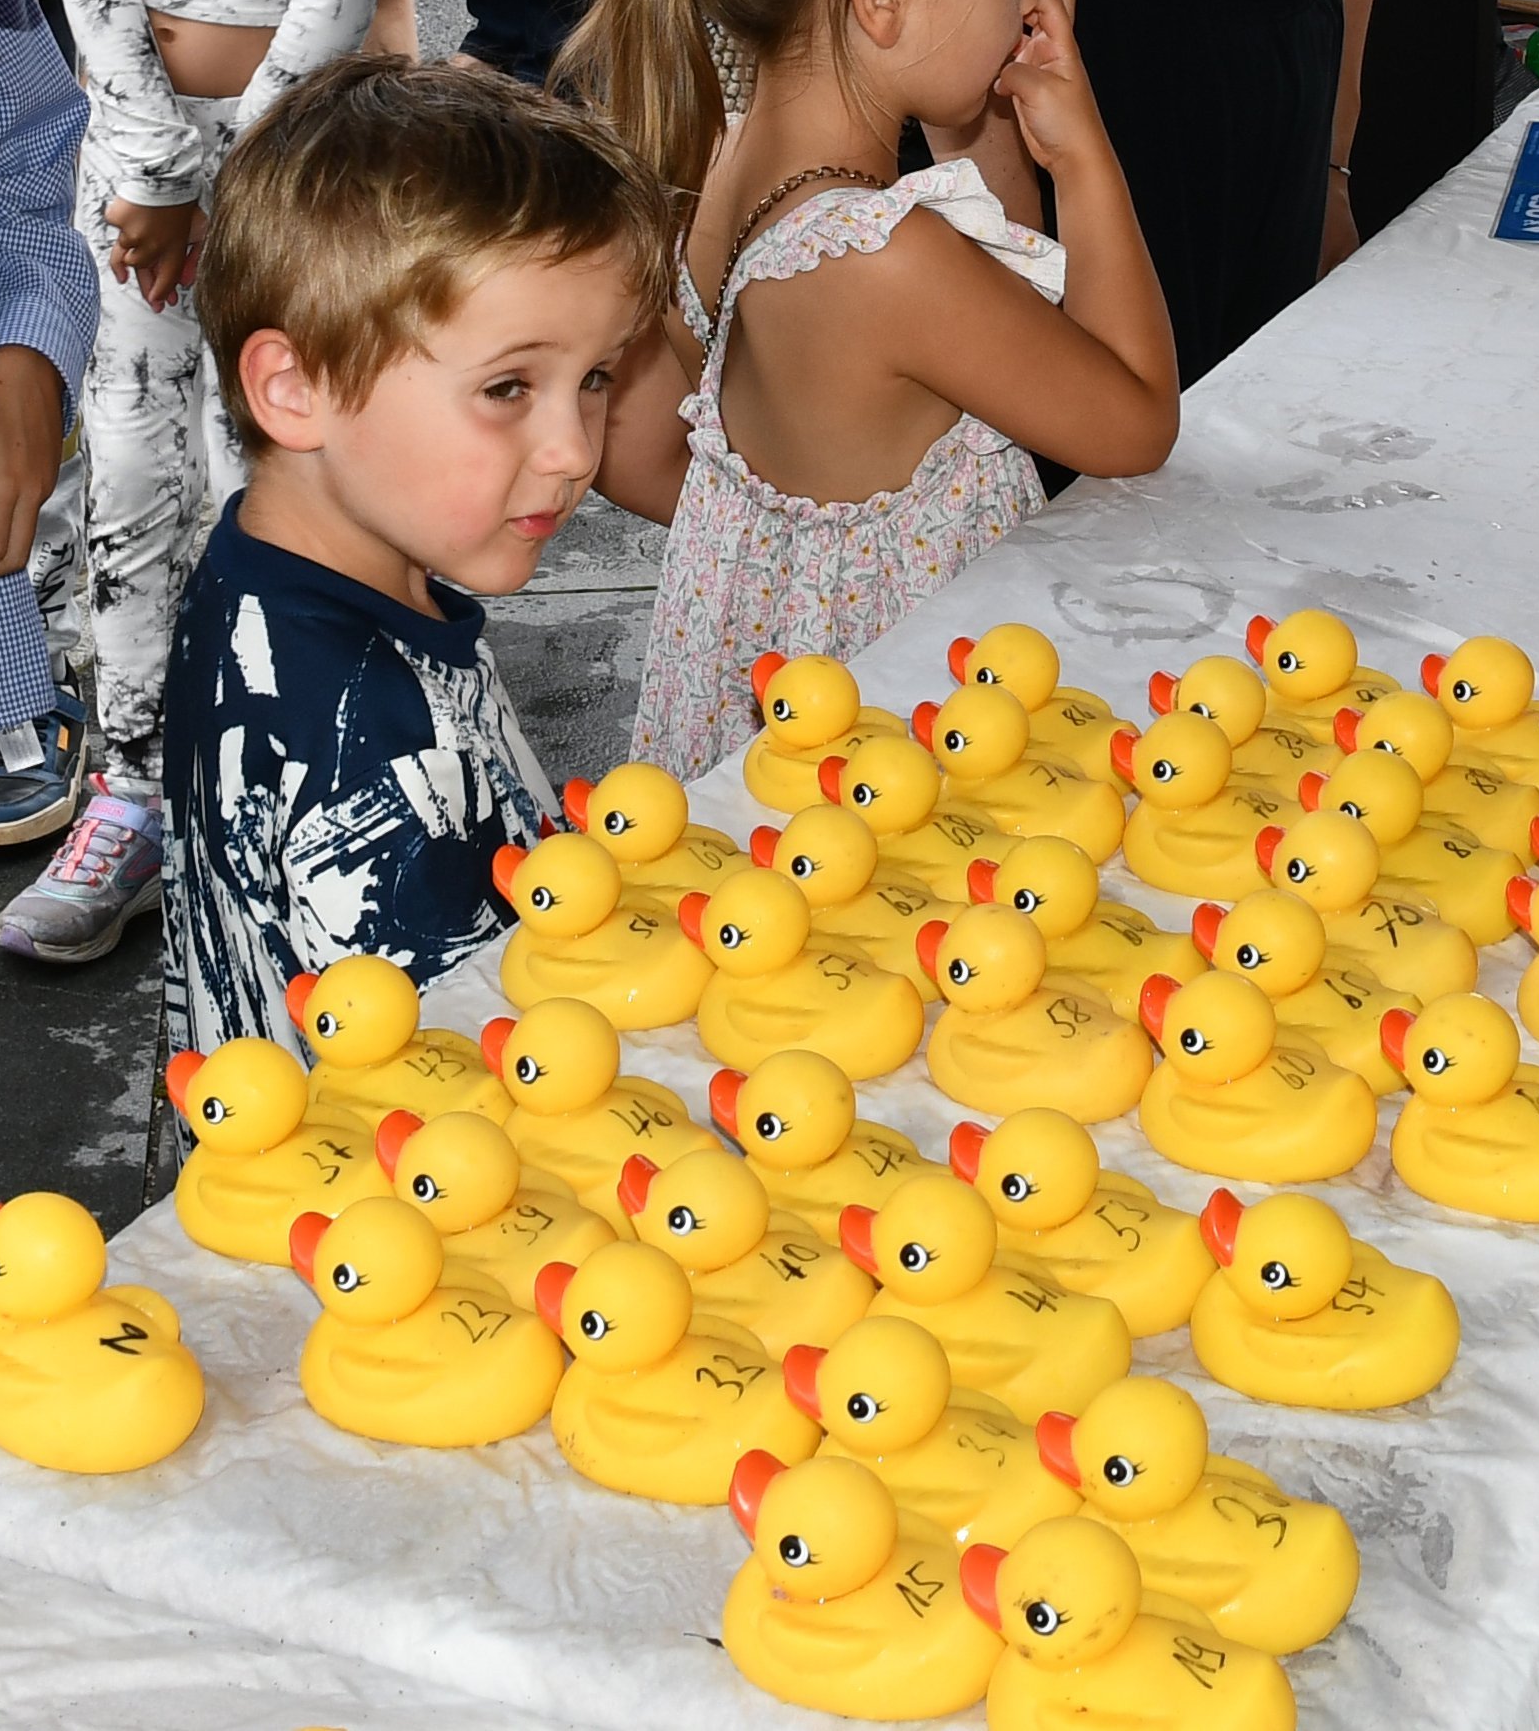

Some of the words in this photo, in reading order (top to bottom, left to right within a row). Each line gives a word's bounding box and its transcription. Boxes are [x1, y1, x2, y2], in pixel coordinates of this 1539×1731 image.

[930, 815, 982, 850] 68
[691, 841, 738, 871] 62
[879, 887, 926, 917] 63
[1359, 901, 1424, 949] 70
[818, 955, 867, 991] 57
[1047, 998, 1092, 1039] 58
[402, 1048, 464, 1082] 43
[1272, 1054, 1313, 1090] 60
[610, 1100, 673, 1139] 46
[300, 1138, 353, 1186] 37
[1094, 1199, 1150, 1253] 53
[758, 1243, 819, 1282] 40
[1331, 1277, 1384, 1316] 54
[438, 1300, 511, 1344] 23
[893, 1561, 943, 1620] 15
[1171, 1637, 1225, 1691] 19
